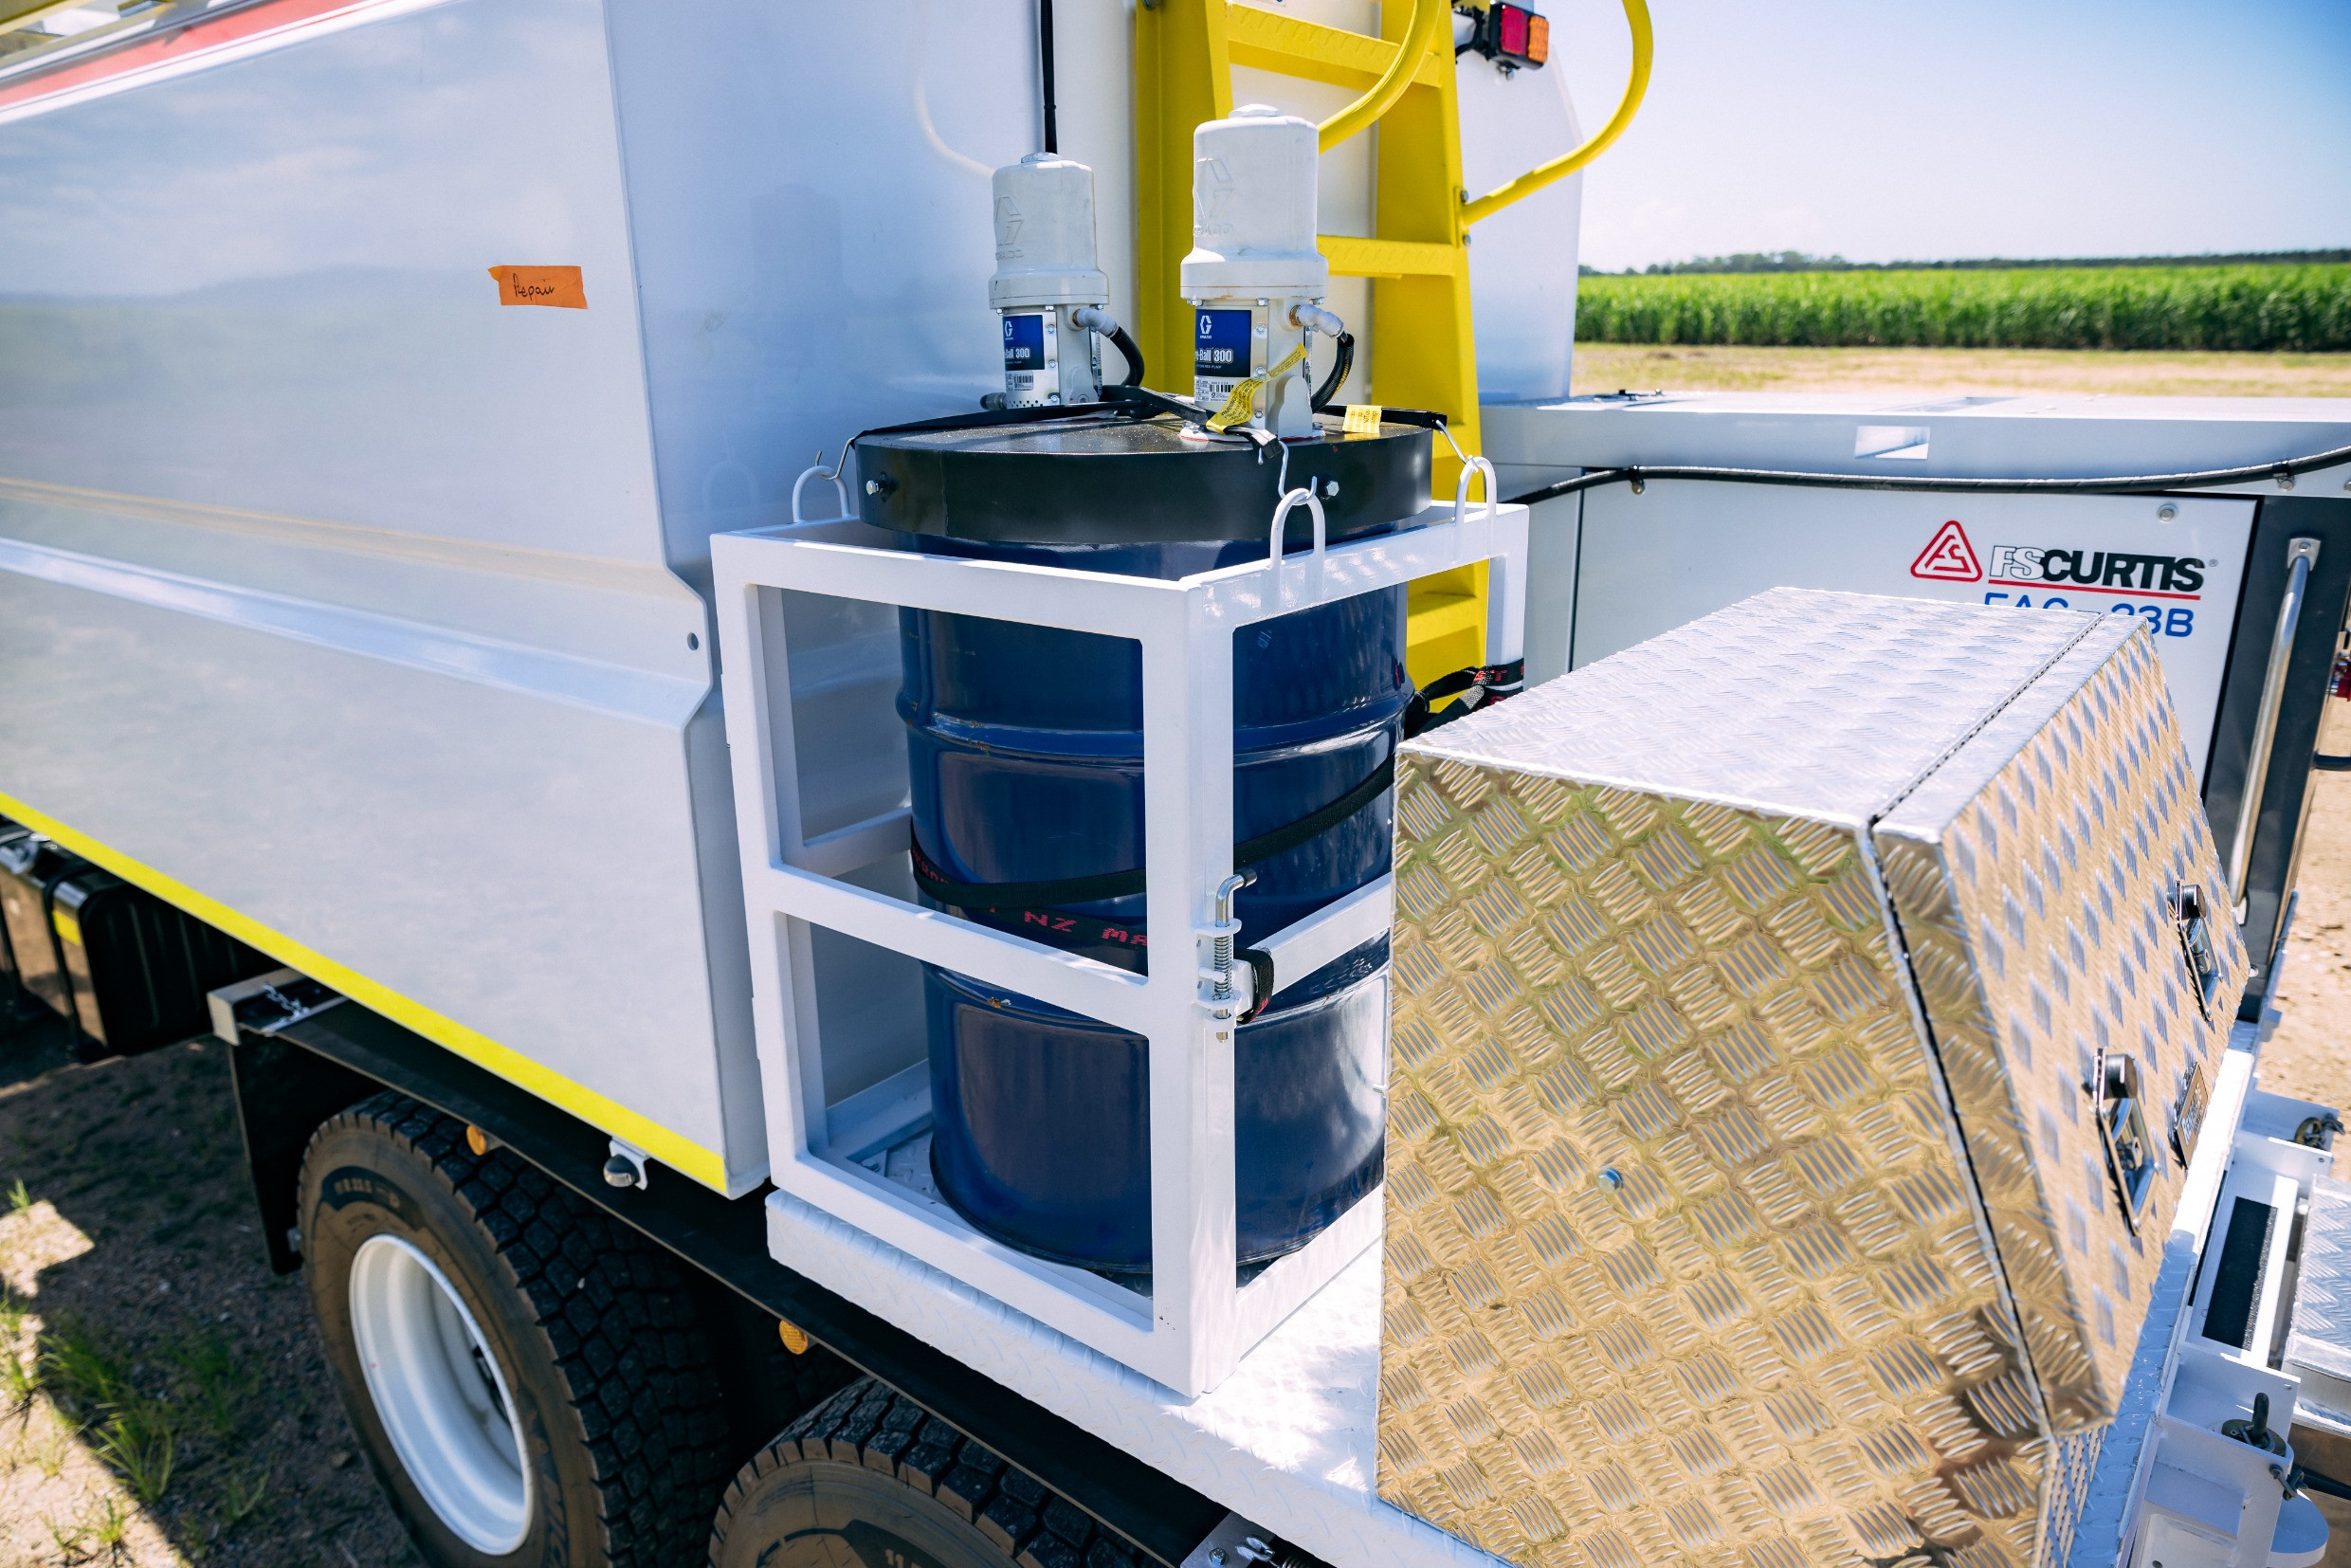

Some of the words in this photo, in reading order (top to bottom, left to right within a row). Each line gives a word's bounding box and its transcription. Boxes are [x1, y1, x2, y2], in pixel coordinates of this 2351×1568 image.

[513, 273, 555, 301] Repair
[1015, 347, 1030, 358] 300
[1213, 349, 1234, 364] 300
[1024, 910, 1077, 933] NZ
[1102, 928, 1147, 946] MA
